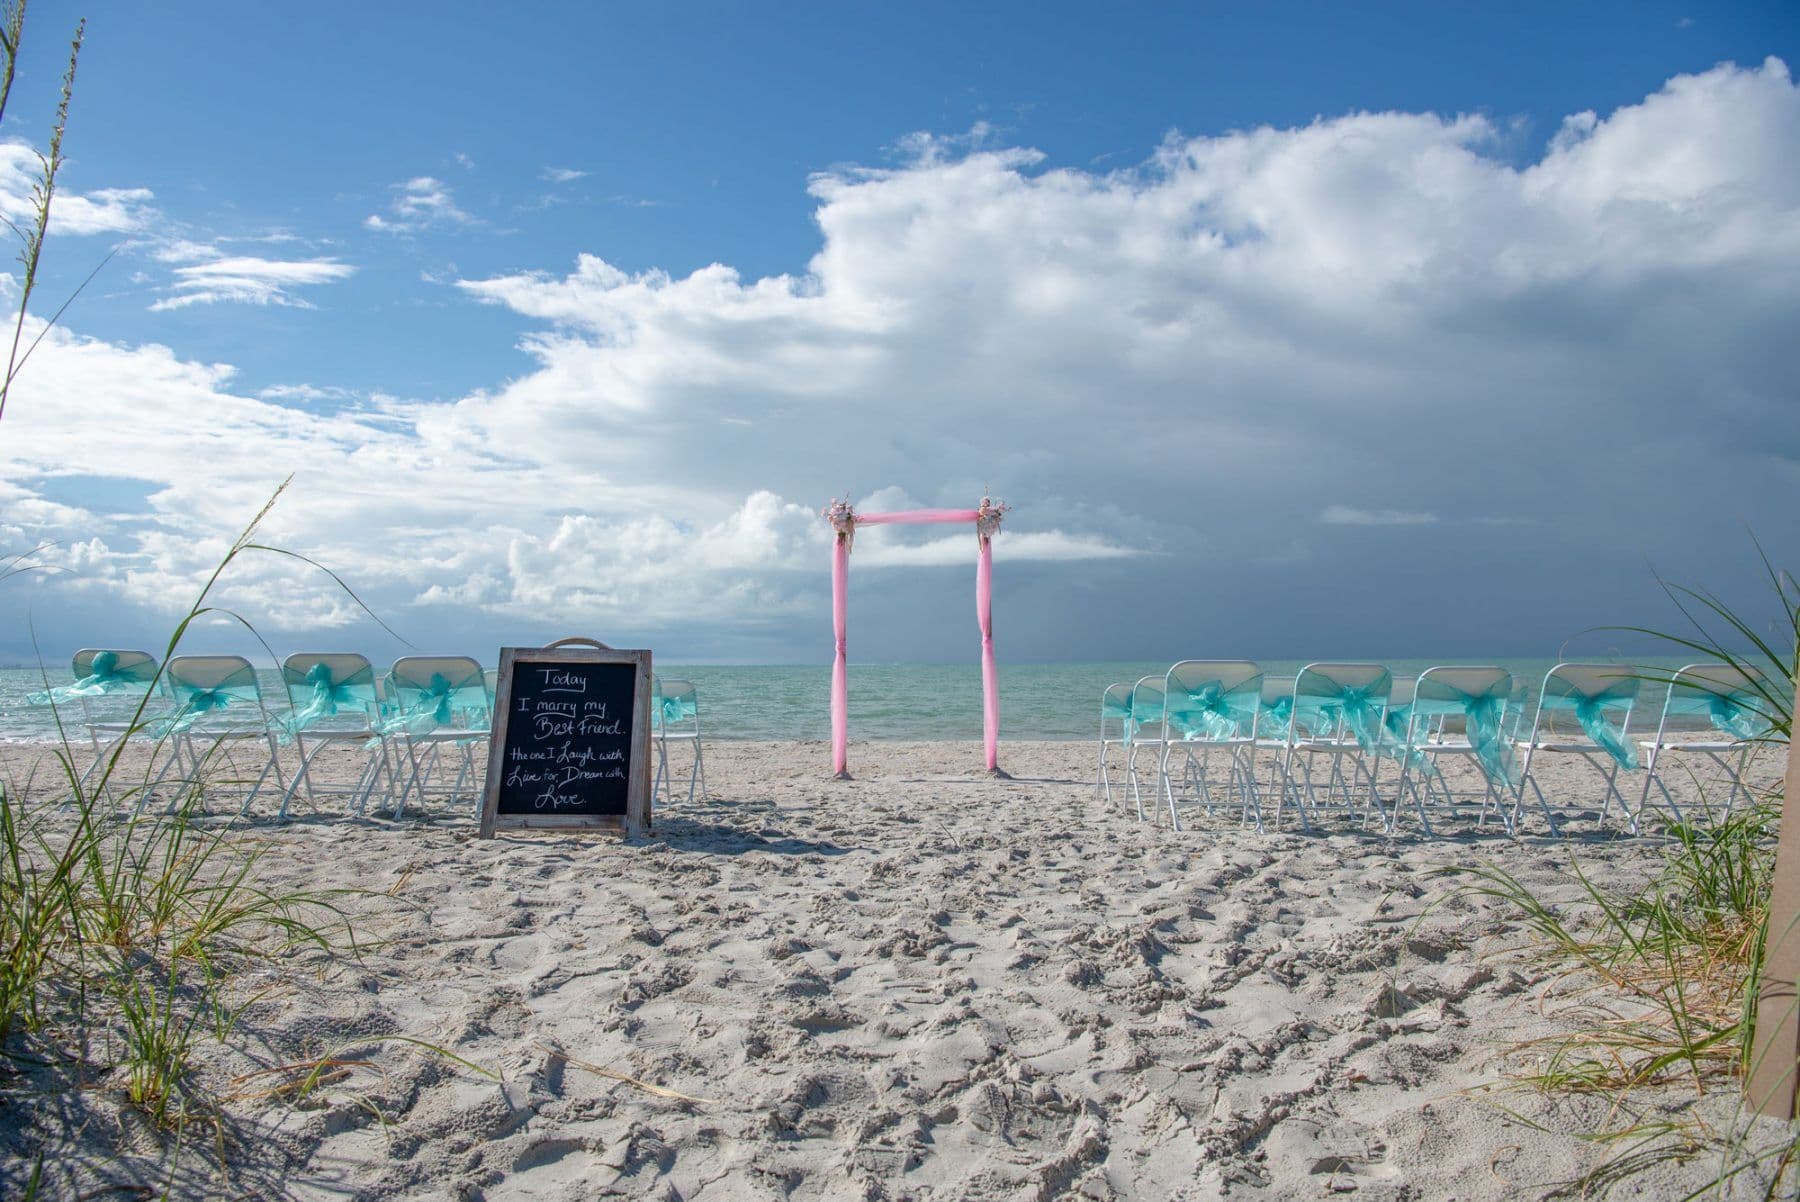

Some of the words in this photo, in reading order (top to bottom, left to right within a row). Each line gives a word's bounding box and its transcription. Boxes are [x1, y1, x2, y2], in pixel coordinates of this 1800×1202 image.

[536, 669, 586, 693] Today
[518, 698, 530, 711] I
[533, 702, 577, 719] marry
[584, 702, 606, 719] my
[534, 717, 575, 740] Best
[511, 747, 528, 760] the
[529, 752, 546, 760] one
[547, 747, 555, 759] I
[556, 741, 596, 767] Laugh
[506, 765, 542, 787] Live
[558, 766, 603, 789] Dream
